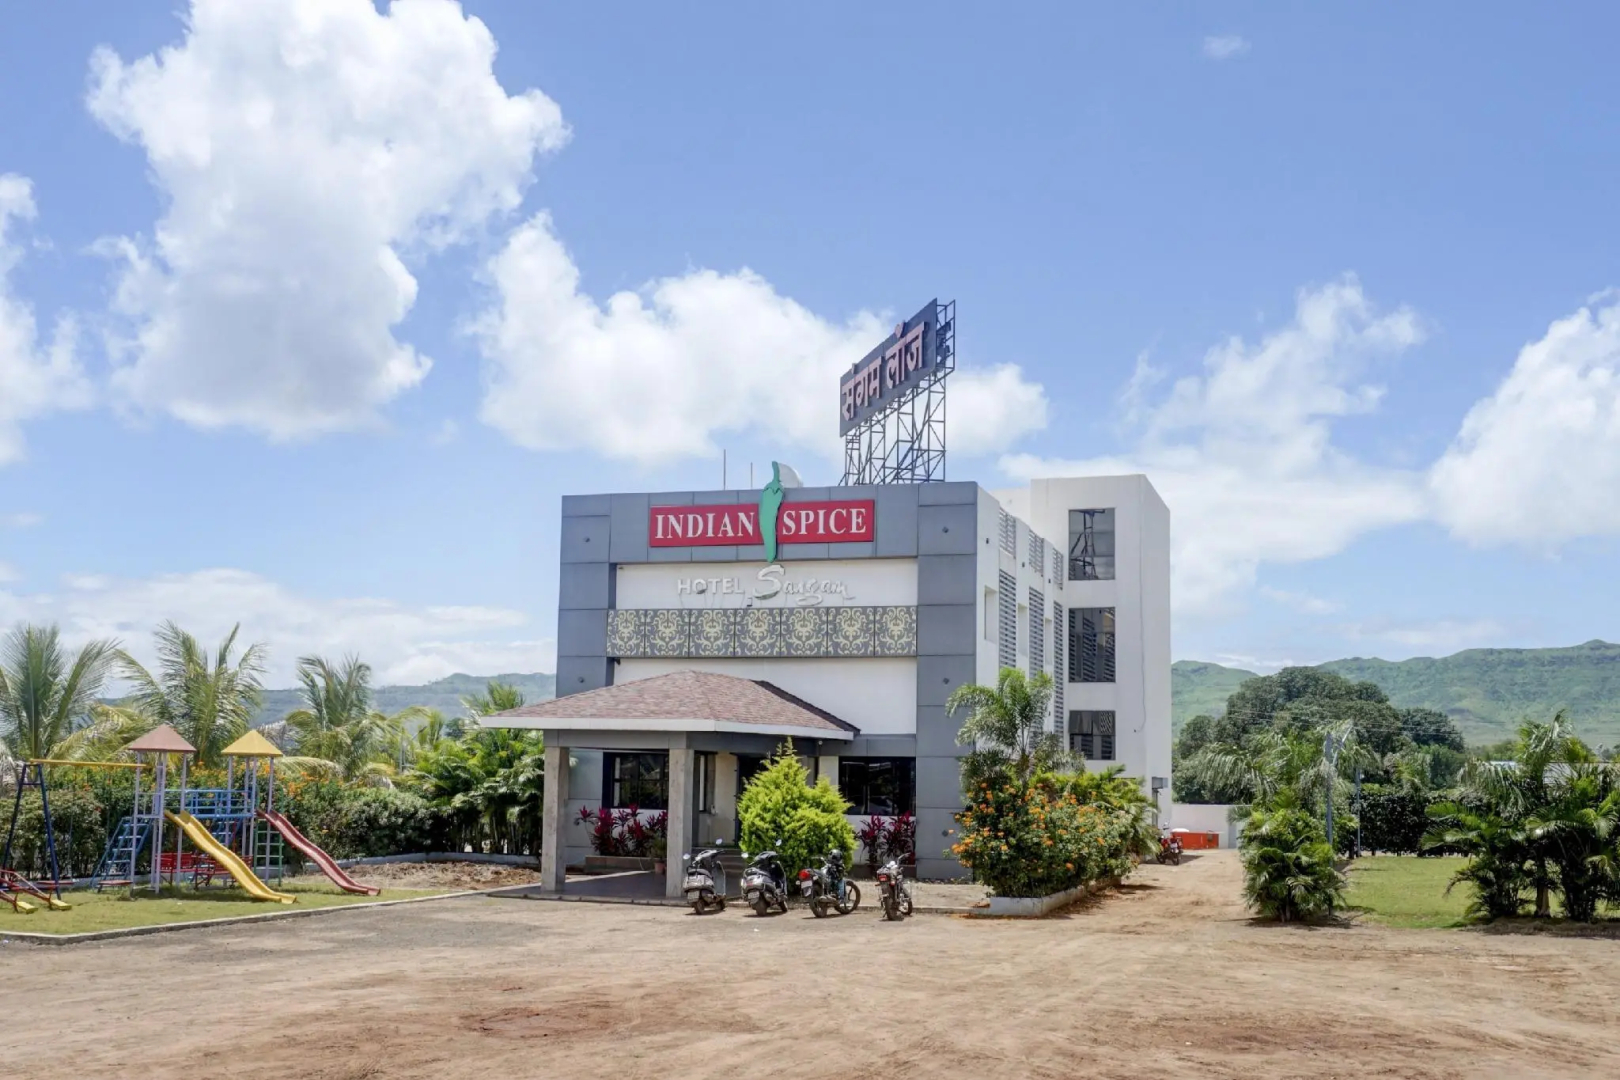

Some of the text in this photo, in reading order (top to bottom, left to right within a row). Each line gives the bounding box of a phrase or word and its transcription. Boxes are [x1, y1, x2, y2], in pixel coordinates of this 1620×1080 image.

[655, 508, 867, 539] INDIAN SPICE
[677, 564, 856, 607] HOTEL Sangam
